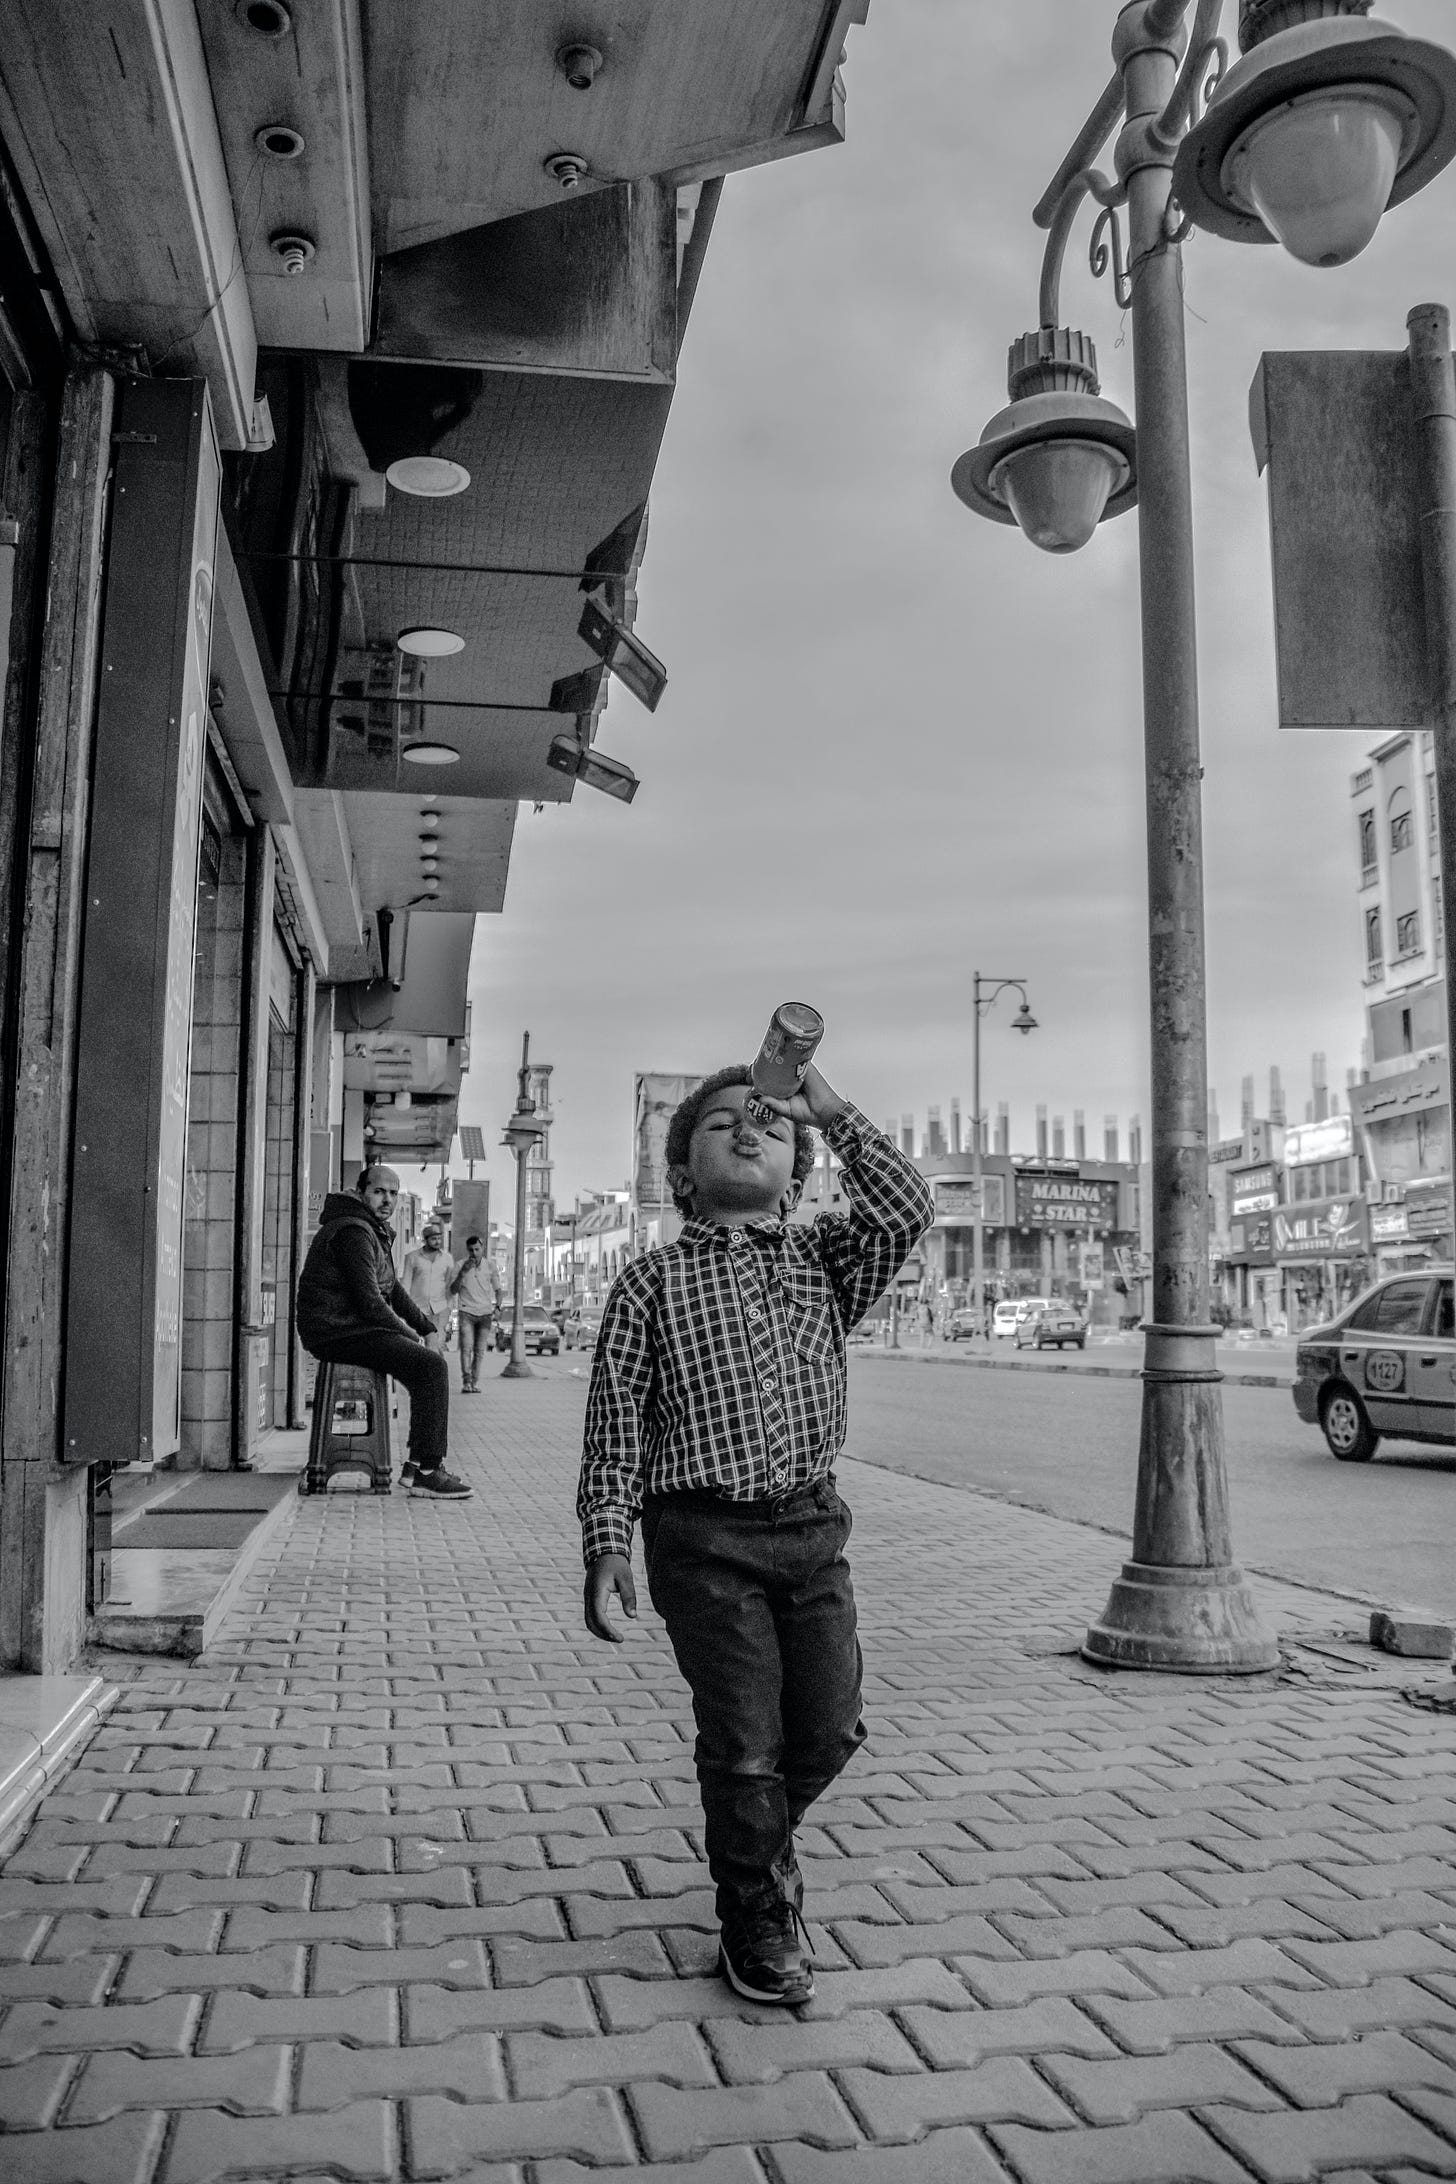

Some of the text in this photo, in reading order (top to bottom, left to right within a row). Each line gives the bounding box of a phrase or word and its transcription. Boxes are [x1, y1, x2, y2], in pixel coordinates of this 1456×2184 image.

[1234, 1172, 1273, 1194] SAMSUNG
[1031, 1183, 1101, 1203] MARINA
[1045, 1204, 1088, 1222] STAR
[1371, 1362, 1398, 1379] 1127
